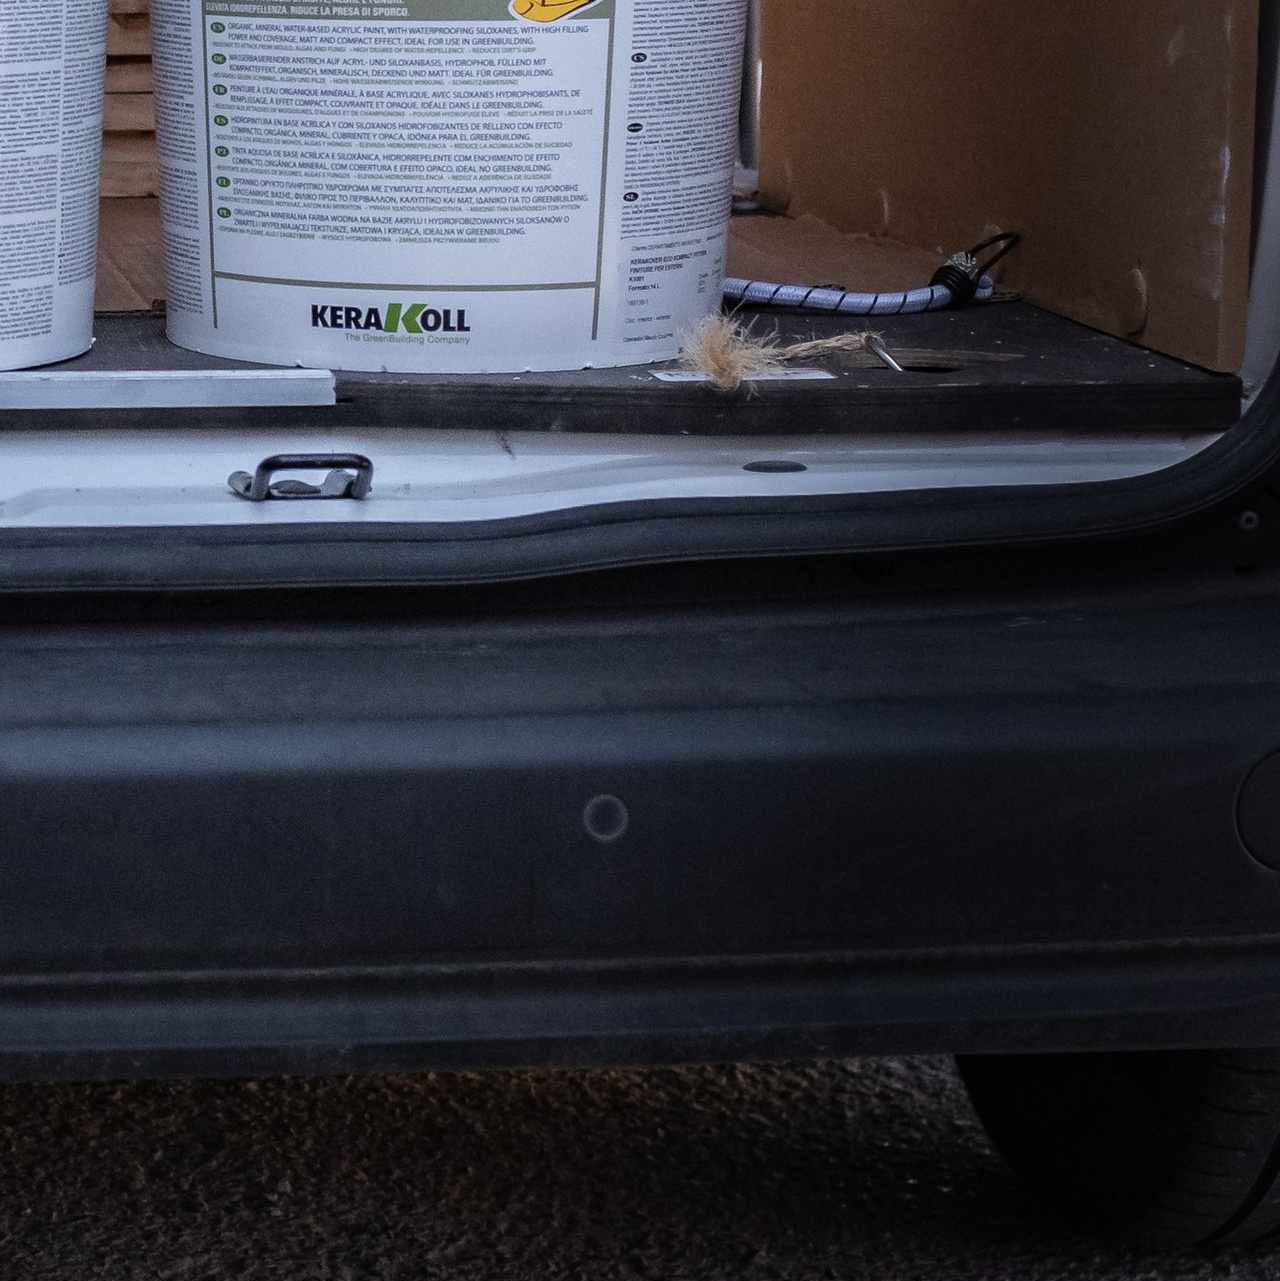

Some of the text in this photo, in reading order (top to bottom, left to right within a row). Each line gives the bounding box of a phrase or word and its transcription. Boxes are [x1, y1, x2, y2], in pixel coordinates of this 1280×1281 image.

[206, 3, 229, 11] ELEVATA
[320, 7, 330, 15] LA
[333, 7, 359, 16] PRESA
[256, 24, 282, 32] MINERAL
[284, 25, 330, 33] WATER-BASED
[332, 26, 362, 34] ACRYLIC
[521, 26, 540, 34] WITH
[228, 33, 248, 41] POWER
[299, 36, 318, 44] MATT
[498, 58, 532, 66] FÜLLEND
[476, 69, 491, 77] FÜR
[280, 88, 318, 96] ORGANIQUE
[366, 90, 385, 98] BASE
[330, 100, 374, 108] COUVRANTE
[231, 116, 272, 126] HIDROPINTURA
[312, 303, 470, 333] KERAKOLL
[345, 333, 469, 345] The GreenBuilding Company
